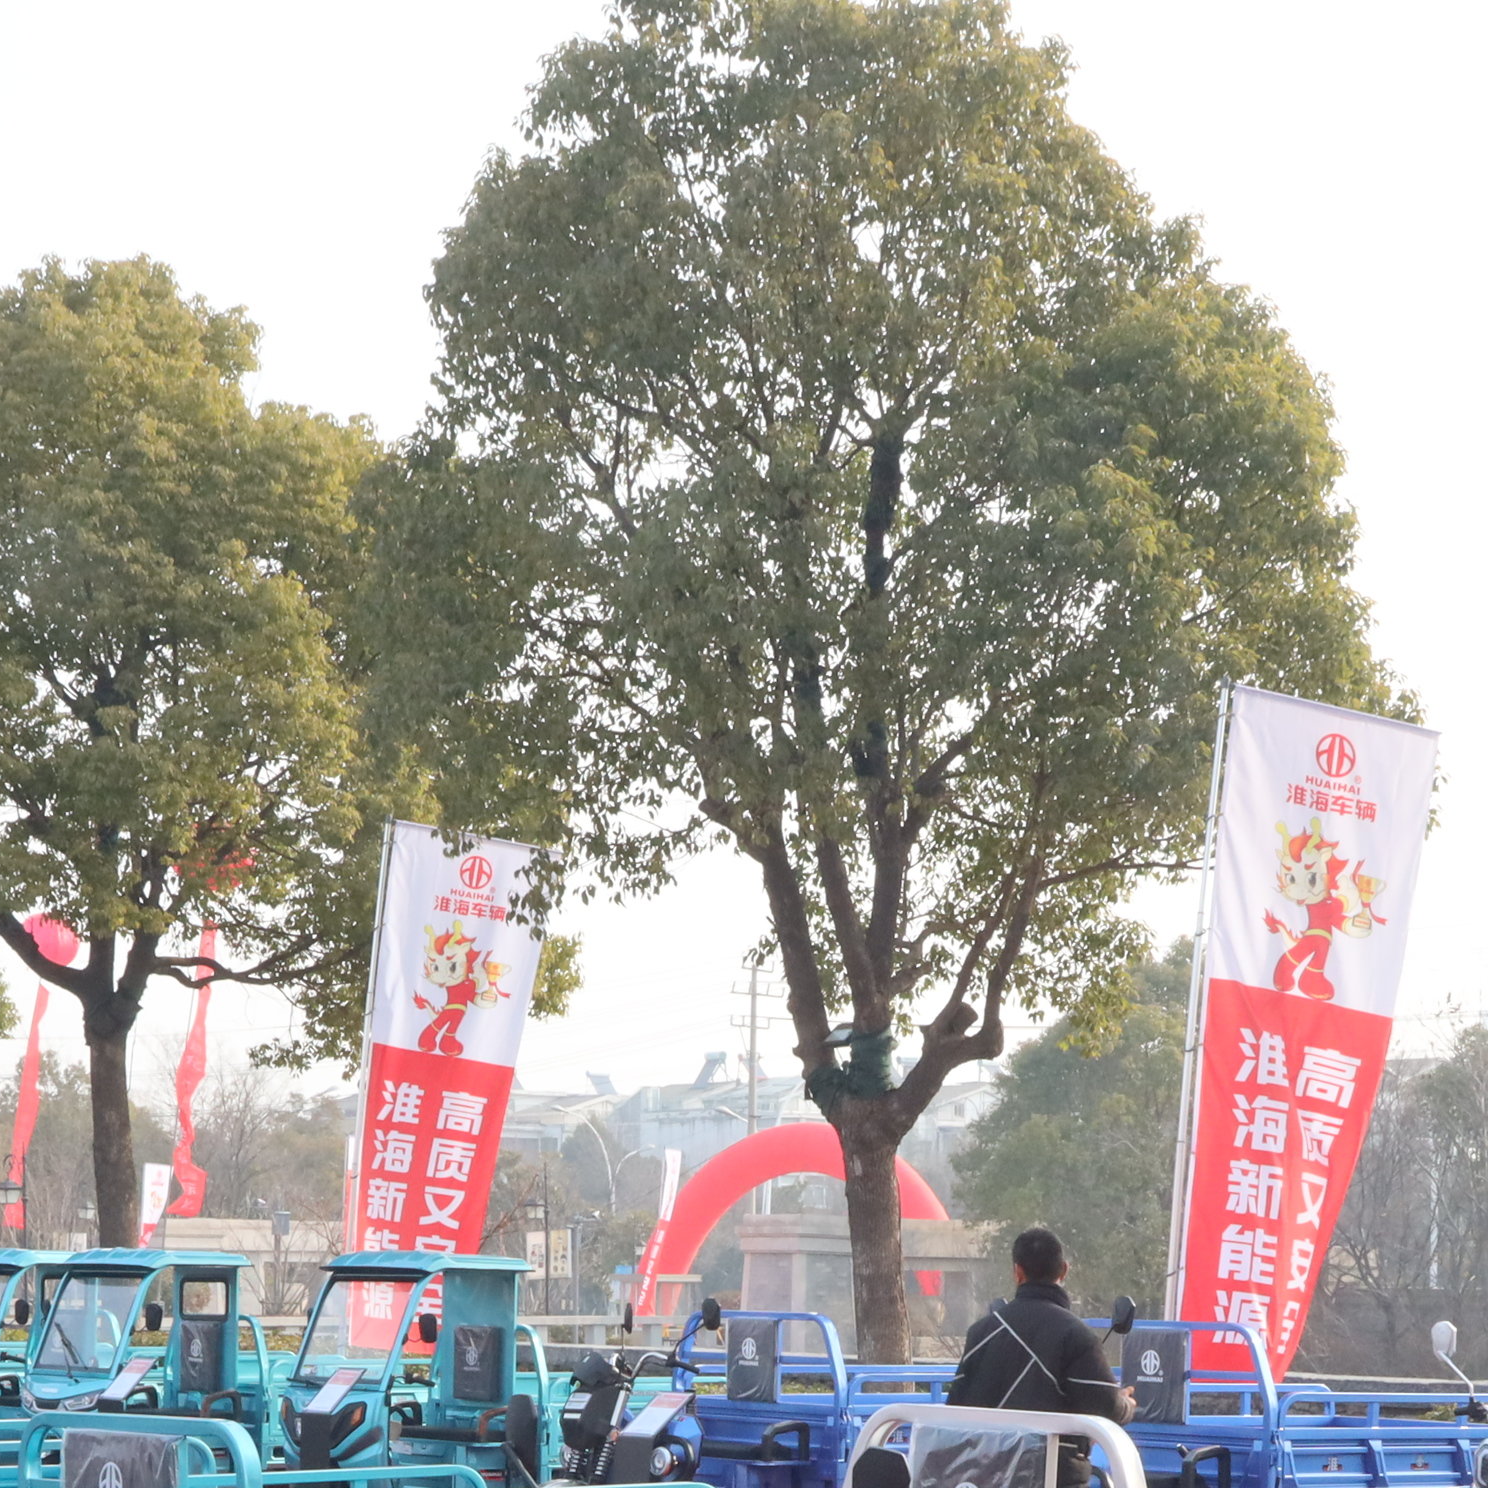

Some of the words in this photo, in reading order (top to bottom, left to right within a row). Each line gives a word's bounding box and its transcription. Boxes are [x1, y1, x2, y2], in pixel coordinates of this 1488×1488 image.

[1305, 775, 1361, 796] HUAIHAI
[1285, 783, 1377, 823] 淮海车辆
[450, 888, 495, 903] HUAIHAI
[433, 895, 506, 922] 淮海车辆
